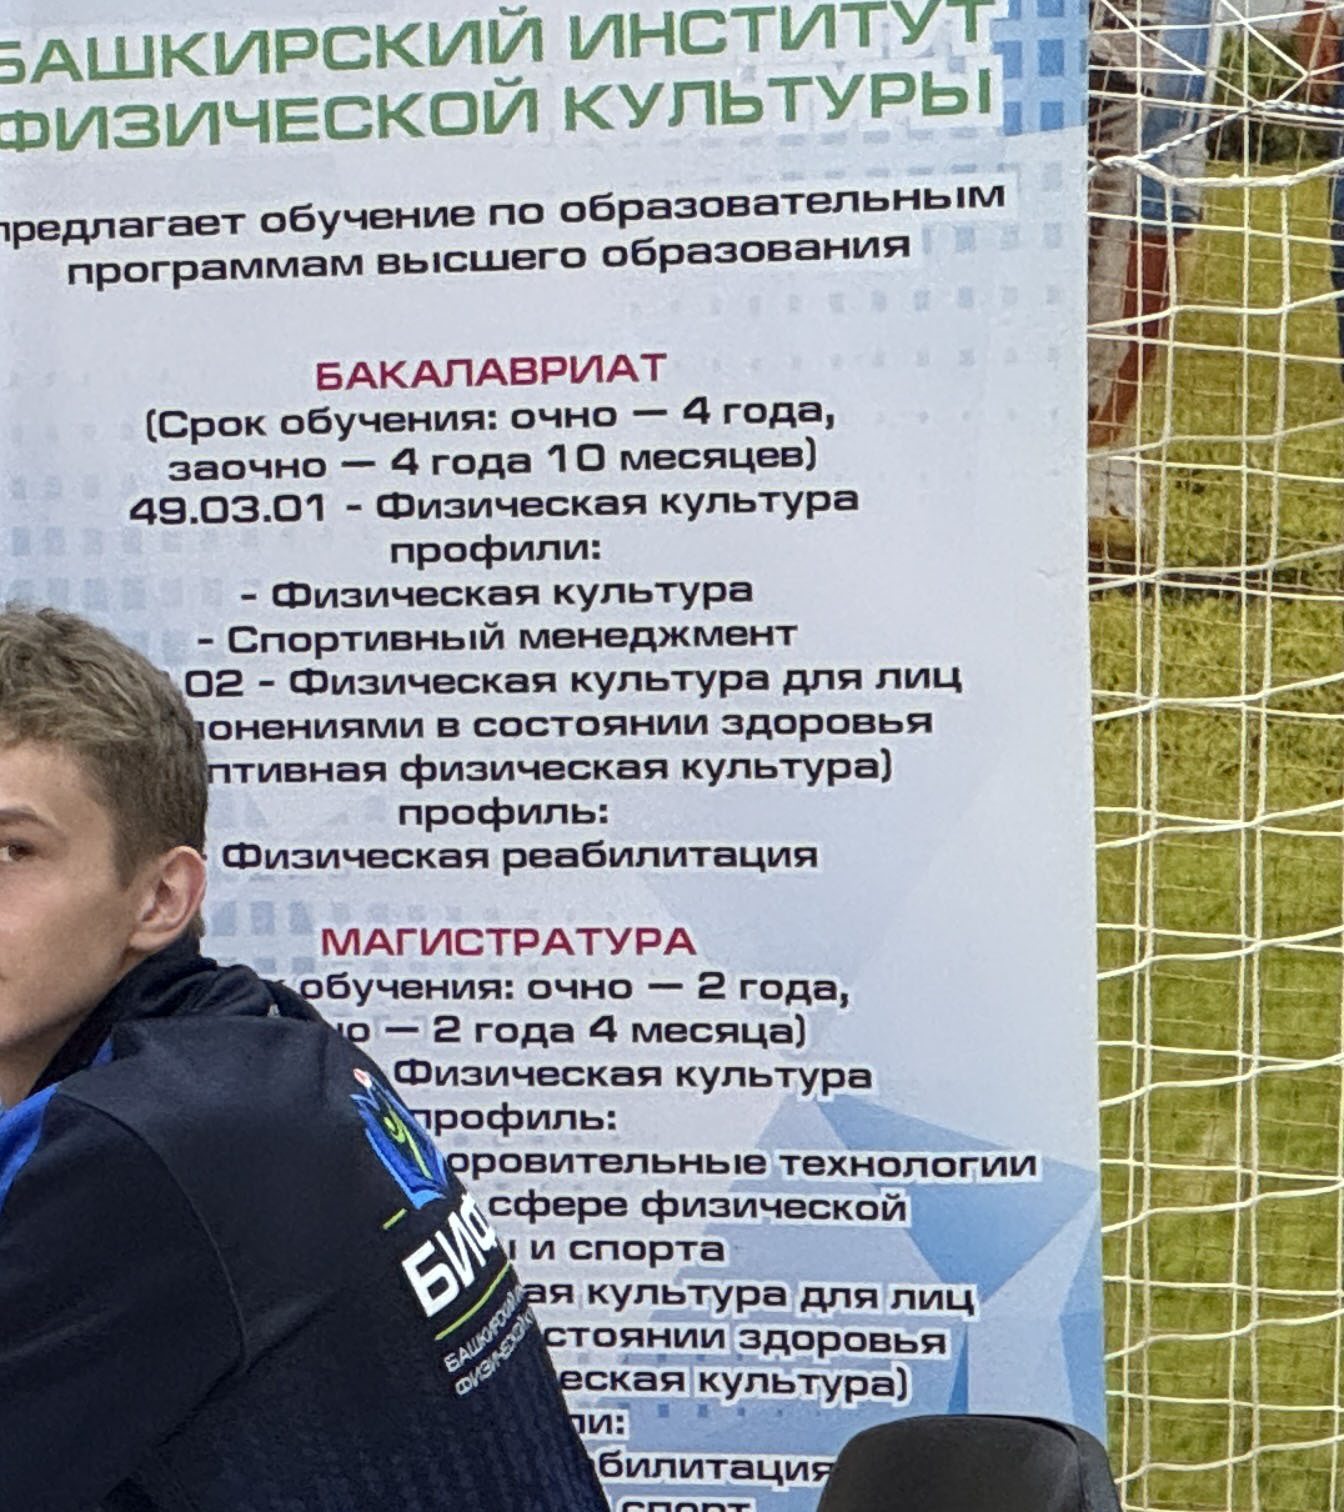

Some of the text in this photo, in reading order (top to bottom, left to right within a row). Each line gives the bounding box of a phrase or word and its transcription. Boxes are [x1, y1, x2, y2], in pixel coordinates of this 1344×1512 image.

[569, 0, 997, 61] ИНСТИТУТ
[564, 68, 991, 131] КУЛЬТУРЫ
[259, 203, 475, 240] обучение
[488, 202, 544, 227] по
[560, 184, 1006, 229] образовательным
[67, 234, 910, 291] программам высшего образования
[315, 353, 668, 391] БАКАЛАВРИАТ
[146, 407, 268, 445] (Срок
[280, 405, 497, 442] обучения:
[510, 405, 617, 430] очно
[682, 396, 711, 425] 4
[723, 398, 836, 430] года,
[168, 457, 327, 482] заочно
[390, 447, 419, 475] 4
[430, 449, 532, 481] года
[547, 442, 606, 474] 10
[619, 437, 817, 474] месяцев)
[128, 493, 326, 526] 49.03.01
[376, 490, 648, 522] Физическая
[660, 488, 859, 521] культура
[390, 534, 602, 570] профили:
[272, 580, 541, 609] Физическая
[554, 579, 754, 612] культура
[227, 622, 506, 659] Спортивный
[519, 622, 799, 653] менеджмент
[289, 667, 557, 699] Физическая
[570, 666, 770, 700] культура
[782, 667, 863, 695] для
[875, 666, 963, 692] лиц
[437, 716, 460, 737] в
[473, 713, 709, 738] состоянии
[721, 711, 934, 742] здоровья
[400, 754, 669, 790] физическая
[681, 748, 893, 786] культура)
[398, 797, 609, 832] профиль:
[222, 841, 819, 876] Физическая реабилитация
[321, 927, 698, 956] МАГИСТРАТУРА
[300, 972, 513, 1008] обучения:
[527, 978, 633, 1001] очно
[698, 971, 726, 1000] 2
[740, 978, 849, 1008] года,
[433, 1015, 461, 1043] 2
[475, 1021, 576, 1049] года
[589, 1015, 618, 1043] 4
[631, 1013, 806, 1049] месяца)
[393, 1058, 873, 1096] Физическая культура
[779, 1153, 1037, 1179] технологии
[488, 1189, 908, 1225] сфере физической
[531, 1239, 555, 1260] и
[568, 1237, 725, 1268] спорта
[588, 1283, 787, 1315] культура
[800, 1285, 879, 1314] для
[890, 1286, 975, 1316] лиц
[738, 1327, 947, 1360] здоровья
[699, 1366, 908, 1401] культура)
